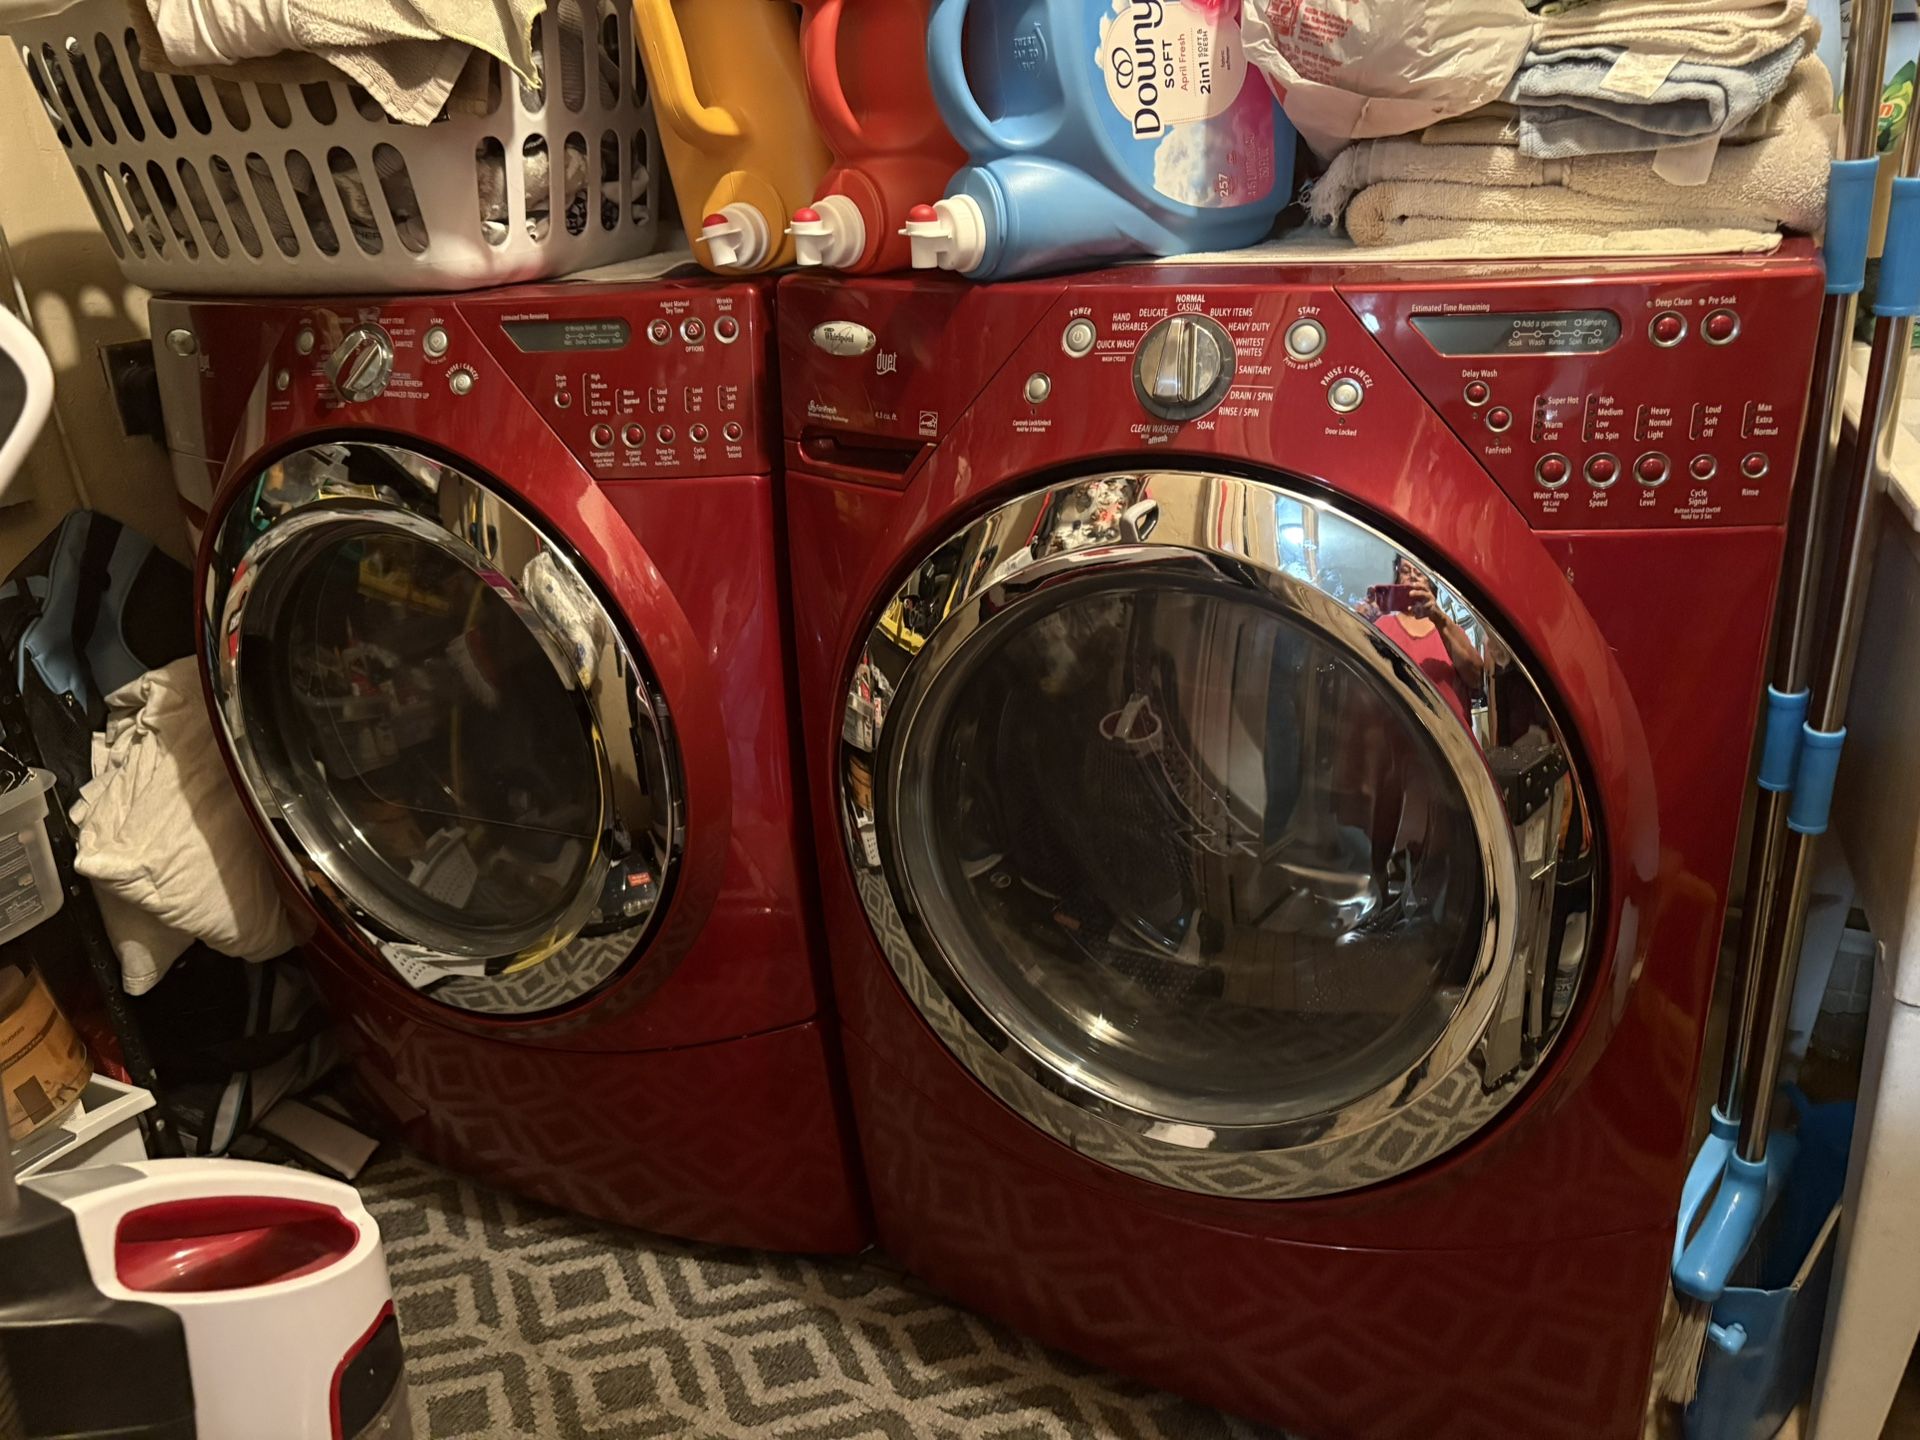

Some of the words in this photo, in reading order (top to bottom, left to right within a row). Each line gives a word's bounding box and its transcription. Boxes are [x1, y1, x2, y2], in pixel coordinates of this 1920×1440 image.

[1178, 33, 1186, 64] Fresh
[1133, 0, 1163, 135] Downy
[1162, 39, 1174, 88] SOFT
[1180, 66, 1189, 91] April
[1199, 60, 1211, 94] 2in1
[1218, 173, 1230, 198] 257
[1176, 294, 1206, 303] NORMAL
[1655, 297, 1672, 308] Deep
[1674, 296, 1692, 307] Clean
[1708, 296, 1719, 306] Pre
[1720, 295, 1736, 305] Soak
[1177, 303, 1202, 312] CASUAL
[1298, 306, 1320, 316] START
[1412, 304, 1442, 312] Estimated
[1443, 304, 1457, 312] Time
[1458, 303, 1490, 312] Remaining
[1069, 308, 1092, 317] POWER
[1139, 308, 1168, 317] DELICATE
[1210, 308, 1232, 317] BULKY
[1232, 308, 1253, 316] ITEMS
[1112, 313, 1130, 322] HAND
[1112, 322, 1148, 332] WASHABLES
[1228, 322, 1251, 332] HEAVY
[1252, 322, 1270, 331] DUTY
[1522, 320, 1534, 328] Add
[1540, 320, 1567, 328] garment
[1583, 318, 1607, 328] Sensing
[824, 332, 854, 344] Whirlpool
[1236, 338, 1264, 346] WHITEST
[1508, 338, 1522, 346] Soak
[1528, 338, 1544, 346] Wash
[1549, 338, 1564, 346] Rinse
[1587, 337, 1604, 346] Done
[1096, 340, 1116, 349] QUICK
[1116, 340, 1135, 348] WASH
[1237, 348, 1263, 357] WHITES
[876, 348, 897, 375] duet
[445, 363, 459, 378] PAUSE
[463, 363, 480, 380] CANCEL
[1238, 366, 1272, 375] SANITARY
[1462, 370, 1480, 379] Delay
[1480, 370, 1498, 378] Wash
[1320, 366, 1342, 386] PAUSE
[1348, 366, 1374, 388] CANCEL
[1230, 391, 1251, 400] DRAIN
[1258, 392, 1273, 401] SPIN
[1548, 396, 1566, 406] Super
[1567, 396, 1579, 404] Hot
[1598, 396, 1614, 406] High
[1218, 407, 1238, 416] RINSE
[1244, 408, 1260, 417] SPIN
[1598, 408, 1624, 416] Medium
[1650, 407, 1670, 416] Heavy
[1705, 405, 1722, 414] Loud
[1757, 403, 1772, 412] Max
[1596, 420, 1610, 428] Low
[1648, 418, 1672, 427] Normal
[1704, 417, 1718, 426] Soft
[1755, 416, 1773, 424] Extra
[1130, 424, 1151, 433] CLEAN
[1152, 424, 1180, 434] WASHER
[1197, 422, 1215, 430] SOAK
[1325, 427, 1338, 436] Door
[1339, 428, 1357, 436] Locked
[1647, 430, 1664, 440] Light
[1702, 429, 1714, 438] Off
[1754, 427, 1778, 436] Normal
[1543, 432, 1558, 441] Cold
[1594, 432, 1605, 440] No
[1606, 432, 1619, 441] Spin
[1485, 446, 1512, 454] FanFresh
[1552, 492, 1569, 500] Temp
[1592, 490, 1606, 499] Spin
[1642, 490, 1654, 498] Soil
[1690, 488, 1708, 498] Cycle
[1742, 488, 1760, 496] Rinse
[1589, 499, 1608, 508] Speed
[1640, 498, 1656, 507] Level
[1688, 498, 1708, 507] Signal
